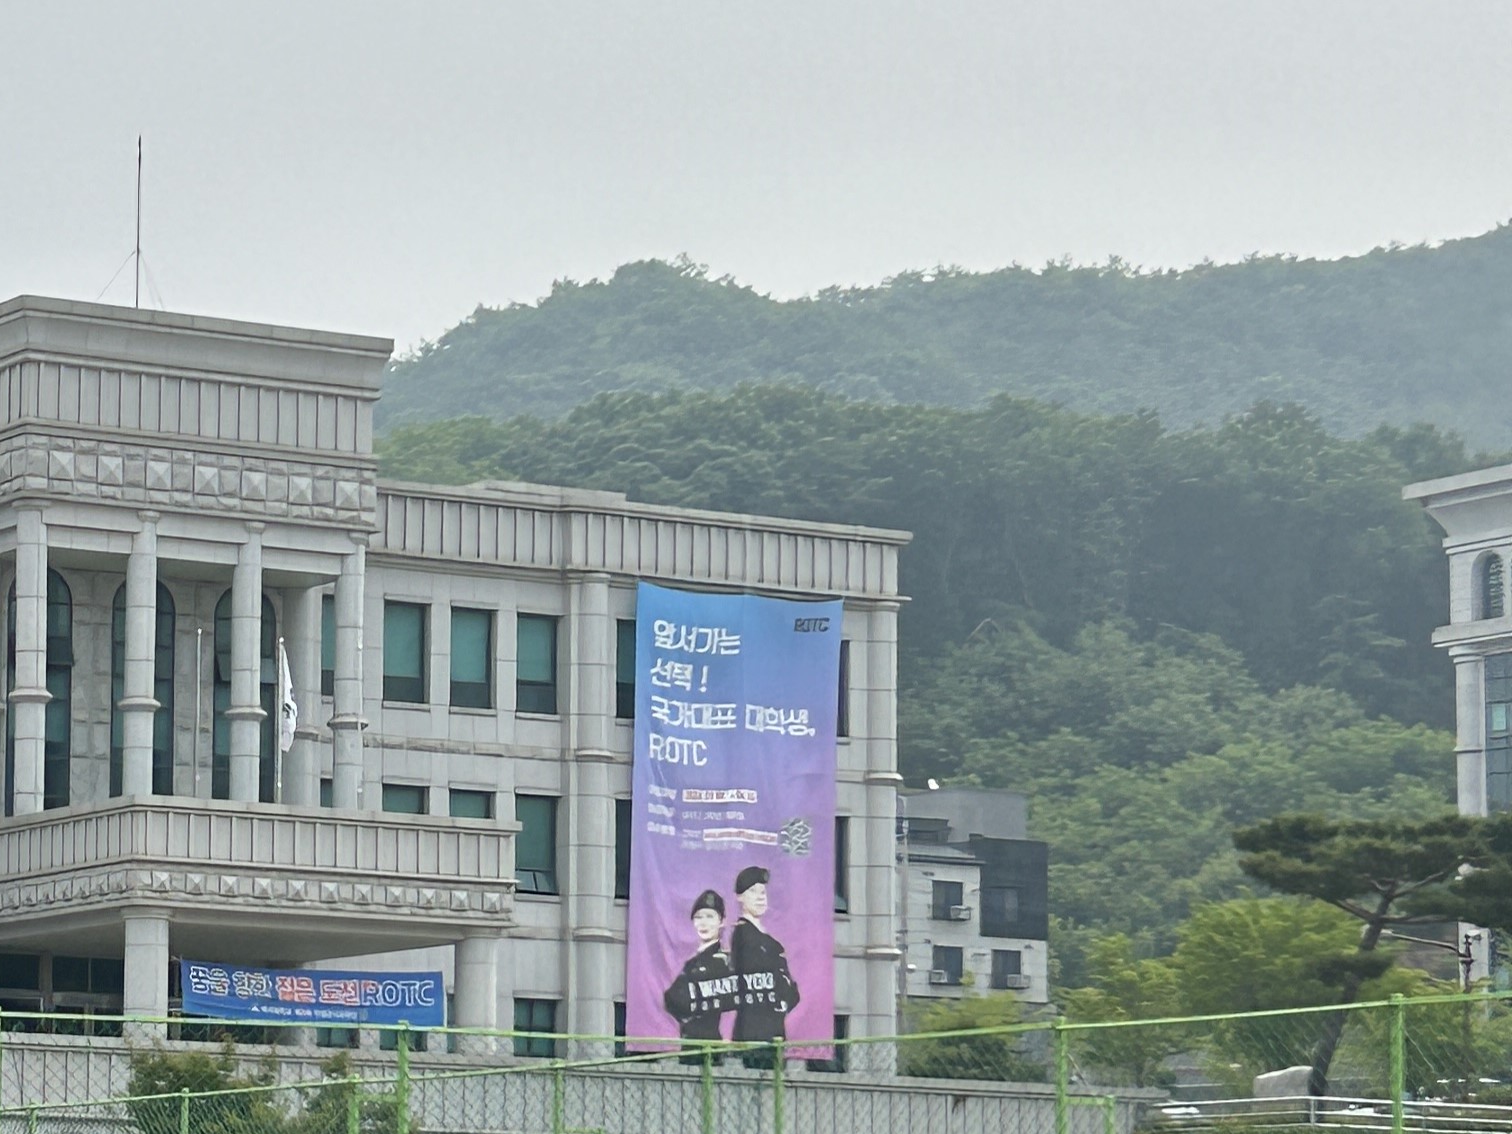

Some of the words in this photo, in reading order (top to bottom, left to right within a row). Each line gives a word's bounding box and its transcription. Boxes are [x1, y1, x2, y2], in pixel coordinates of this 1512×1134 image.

[653, 620, 741, 655] 앞서가는
[651, 696, 737, 729] 국가대표
[745, 703, 816, 737] 대학생
[649, 733, 708, 766] ROTC
[232, 970, 272, 999] 향한
[275, 975, 316, 1004] 젊은
[688, 982, 696, 999] I
[698, 975, 739, 998] WANT
[743, 972, 774, 990] YOU
